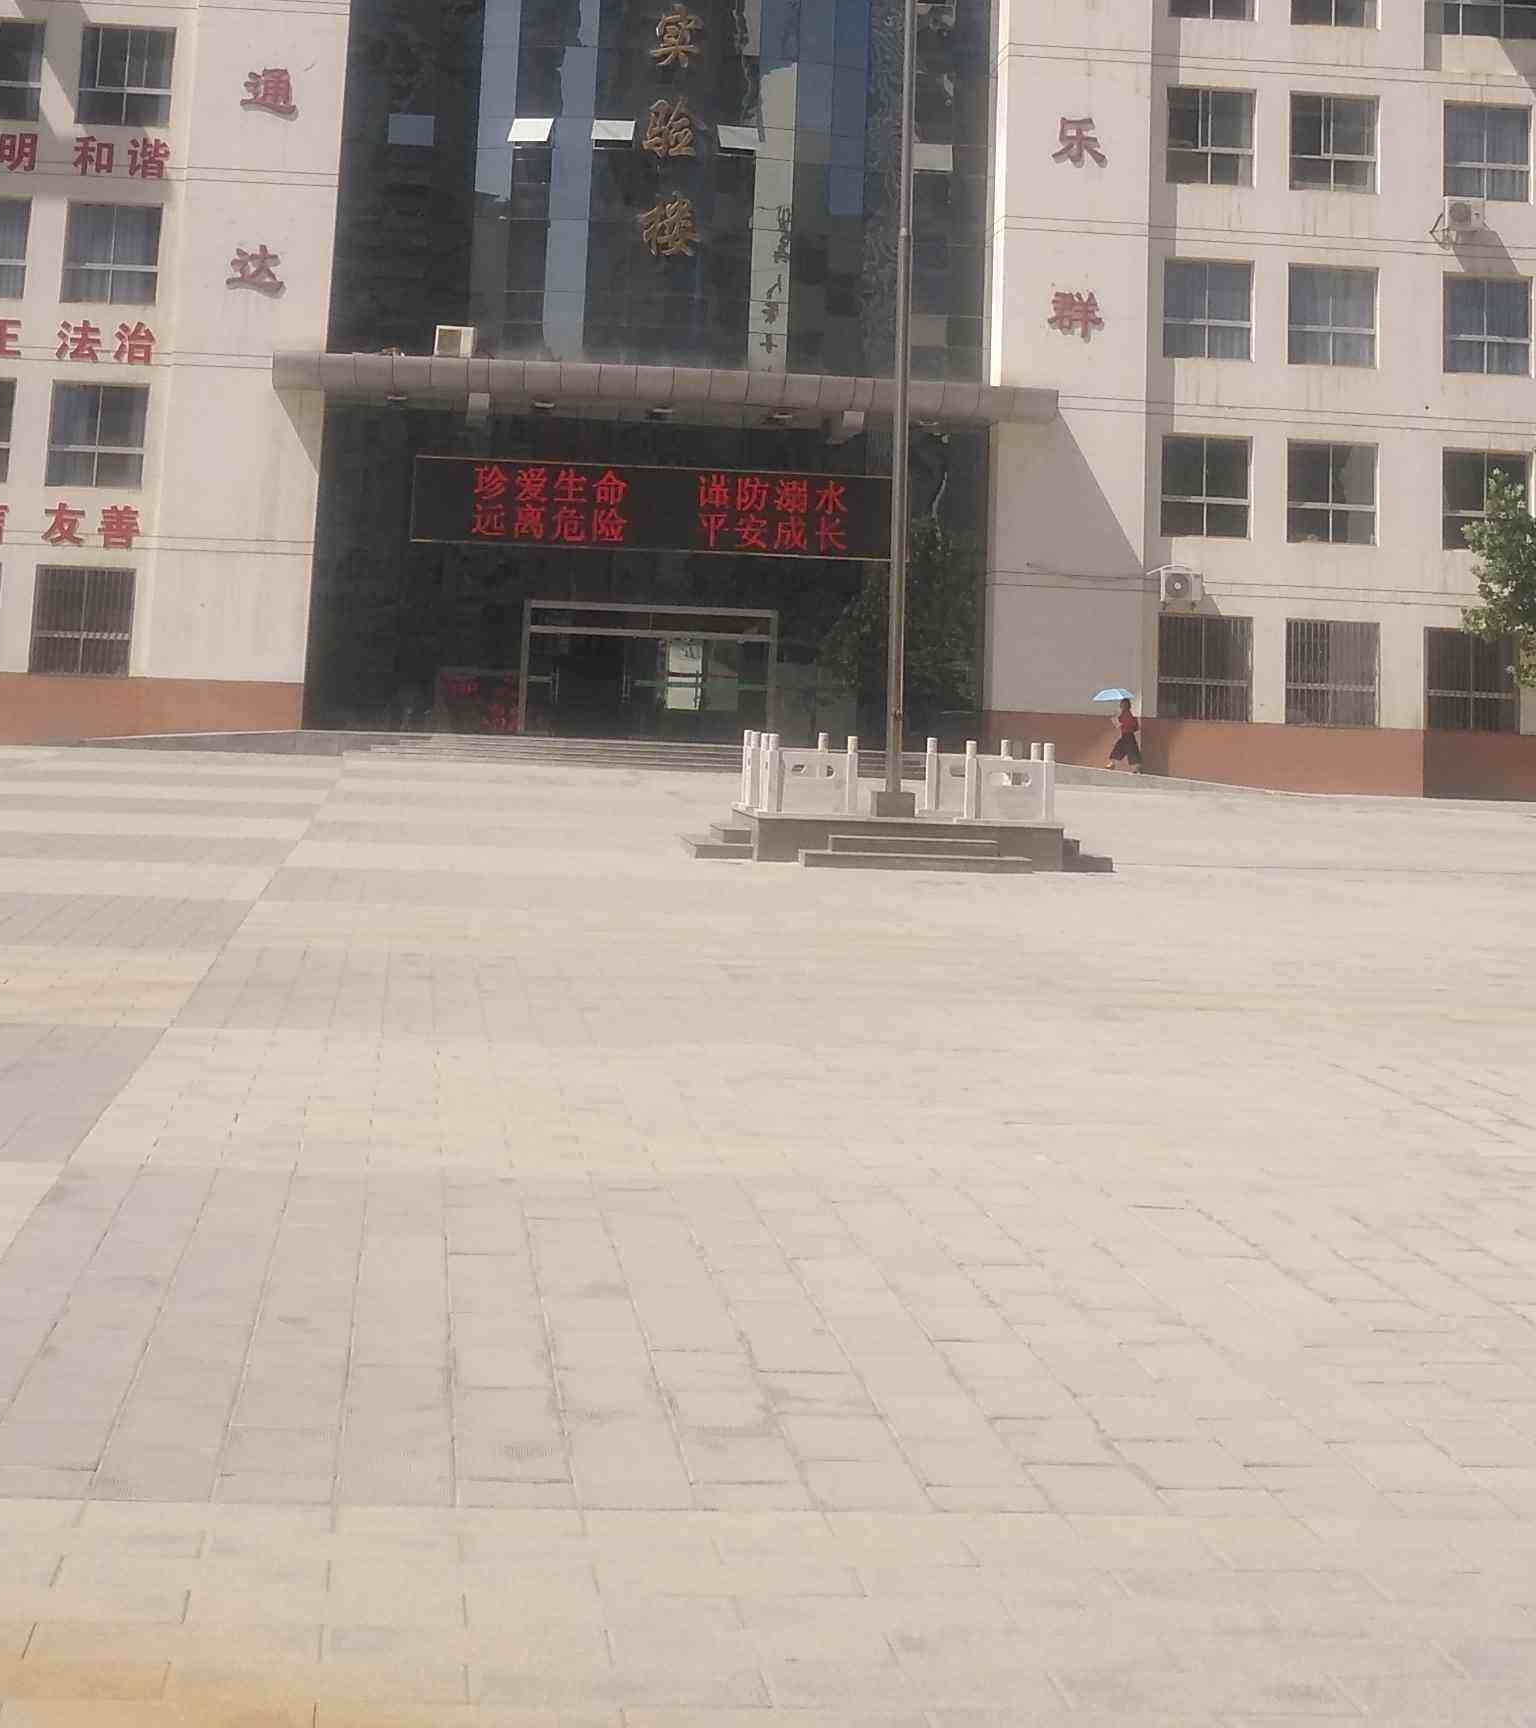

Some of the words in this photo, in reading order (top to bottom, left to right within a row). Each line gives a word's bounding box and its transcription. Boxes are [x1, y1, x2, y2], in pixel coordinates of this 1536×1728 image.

[472, 464, 628, 505] 珍爱生命
[697, 473, 849, 514] 谨防溺水
[471, 503, 628, 544] 远离危险
[697, 511, 849, 552] 平安成长
